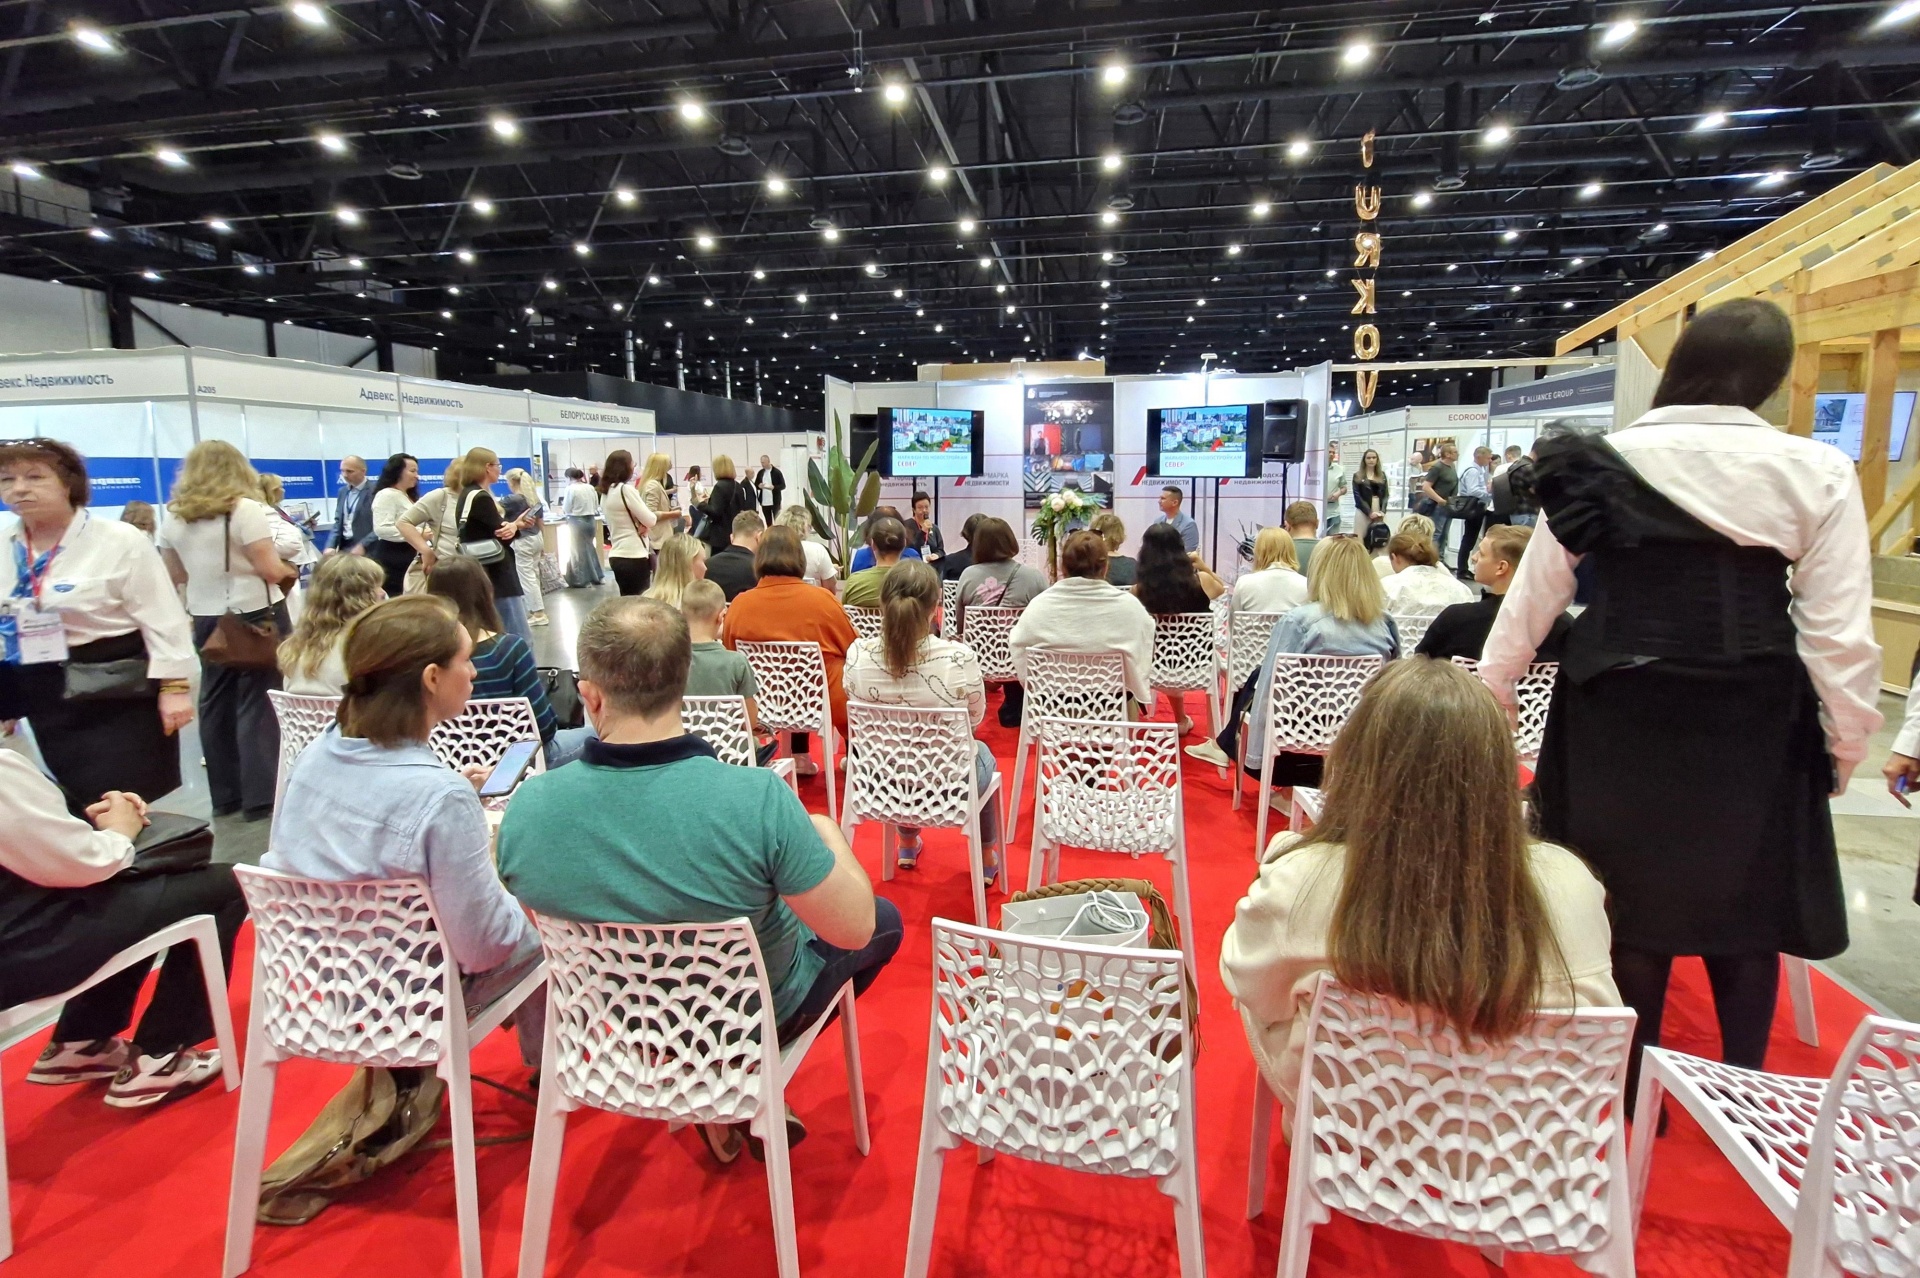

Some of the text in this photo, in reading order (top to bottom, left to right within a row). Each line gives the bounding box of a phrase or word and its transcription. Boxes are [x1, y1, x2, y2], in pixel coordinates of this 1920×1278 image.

[360, 387, 464, 409] Адвекс. Недвижимость
[1526, 392, 1552, 403] ALLIANCE
[1552, 388, 1574, 399] GROUP
[560, 409, 600, 422] БЕЛОРУССКАЯ
[600, 414, 620, 424] МЕБЕЛЬ
[1448, 413, 1488, 421] ECOROOM
